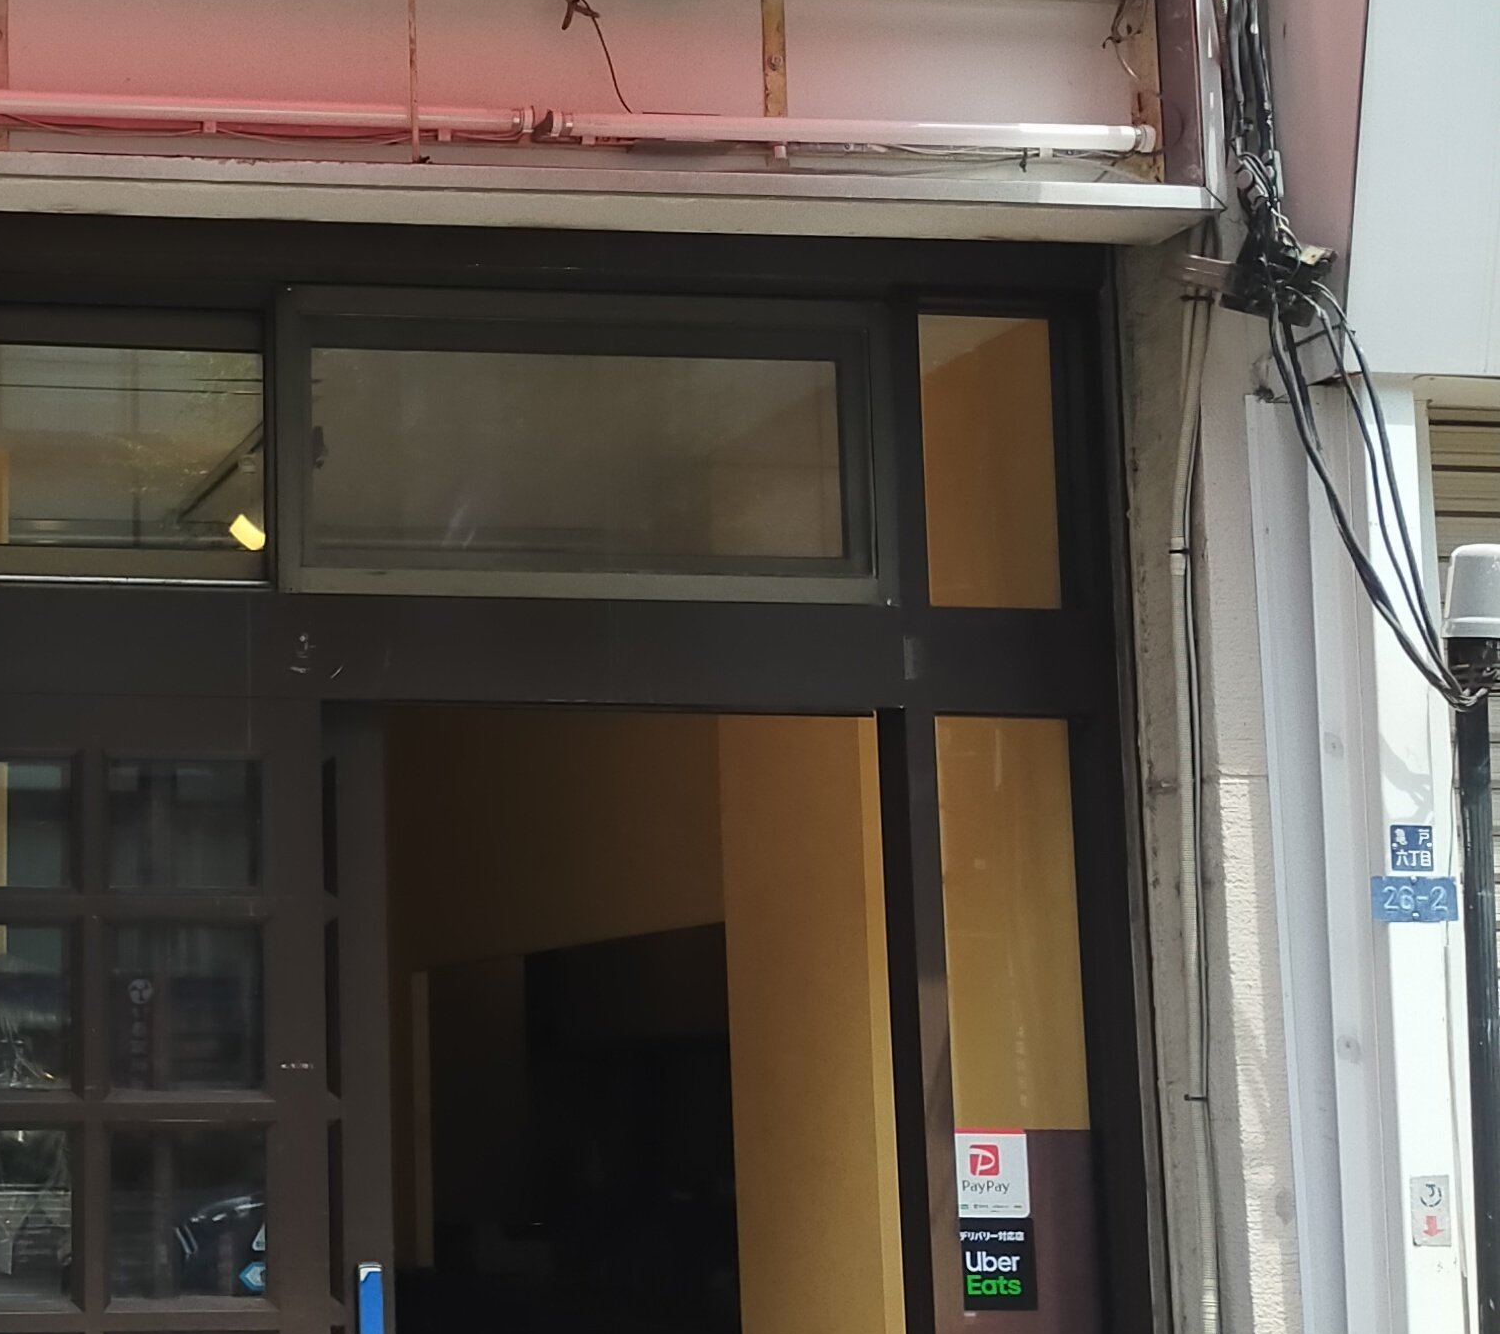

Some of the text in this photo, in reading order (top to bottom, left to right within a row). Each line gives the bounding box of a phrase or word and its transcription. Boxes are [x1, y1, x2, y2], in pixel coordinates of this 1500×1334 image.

[1396, 849, 1432, 867] 六丁目
[1382, 885, 1448, 912] 26-2
[962, 1179, 1010, 1194] PayPay
[959, 1231, 1025, 1242] デリバリー対応店
[965, 1251, 1021, 1272] Uber
[967, 1275, 1022, 1295] Eats
